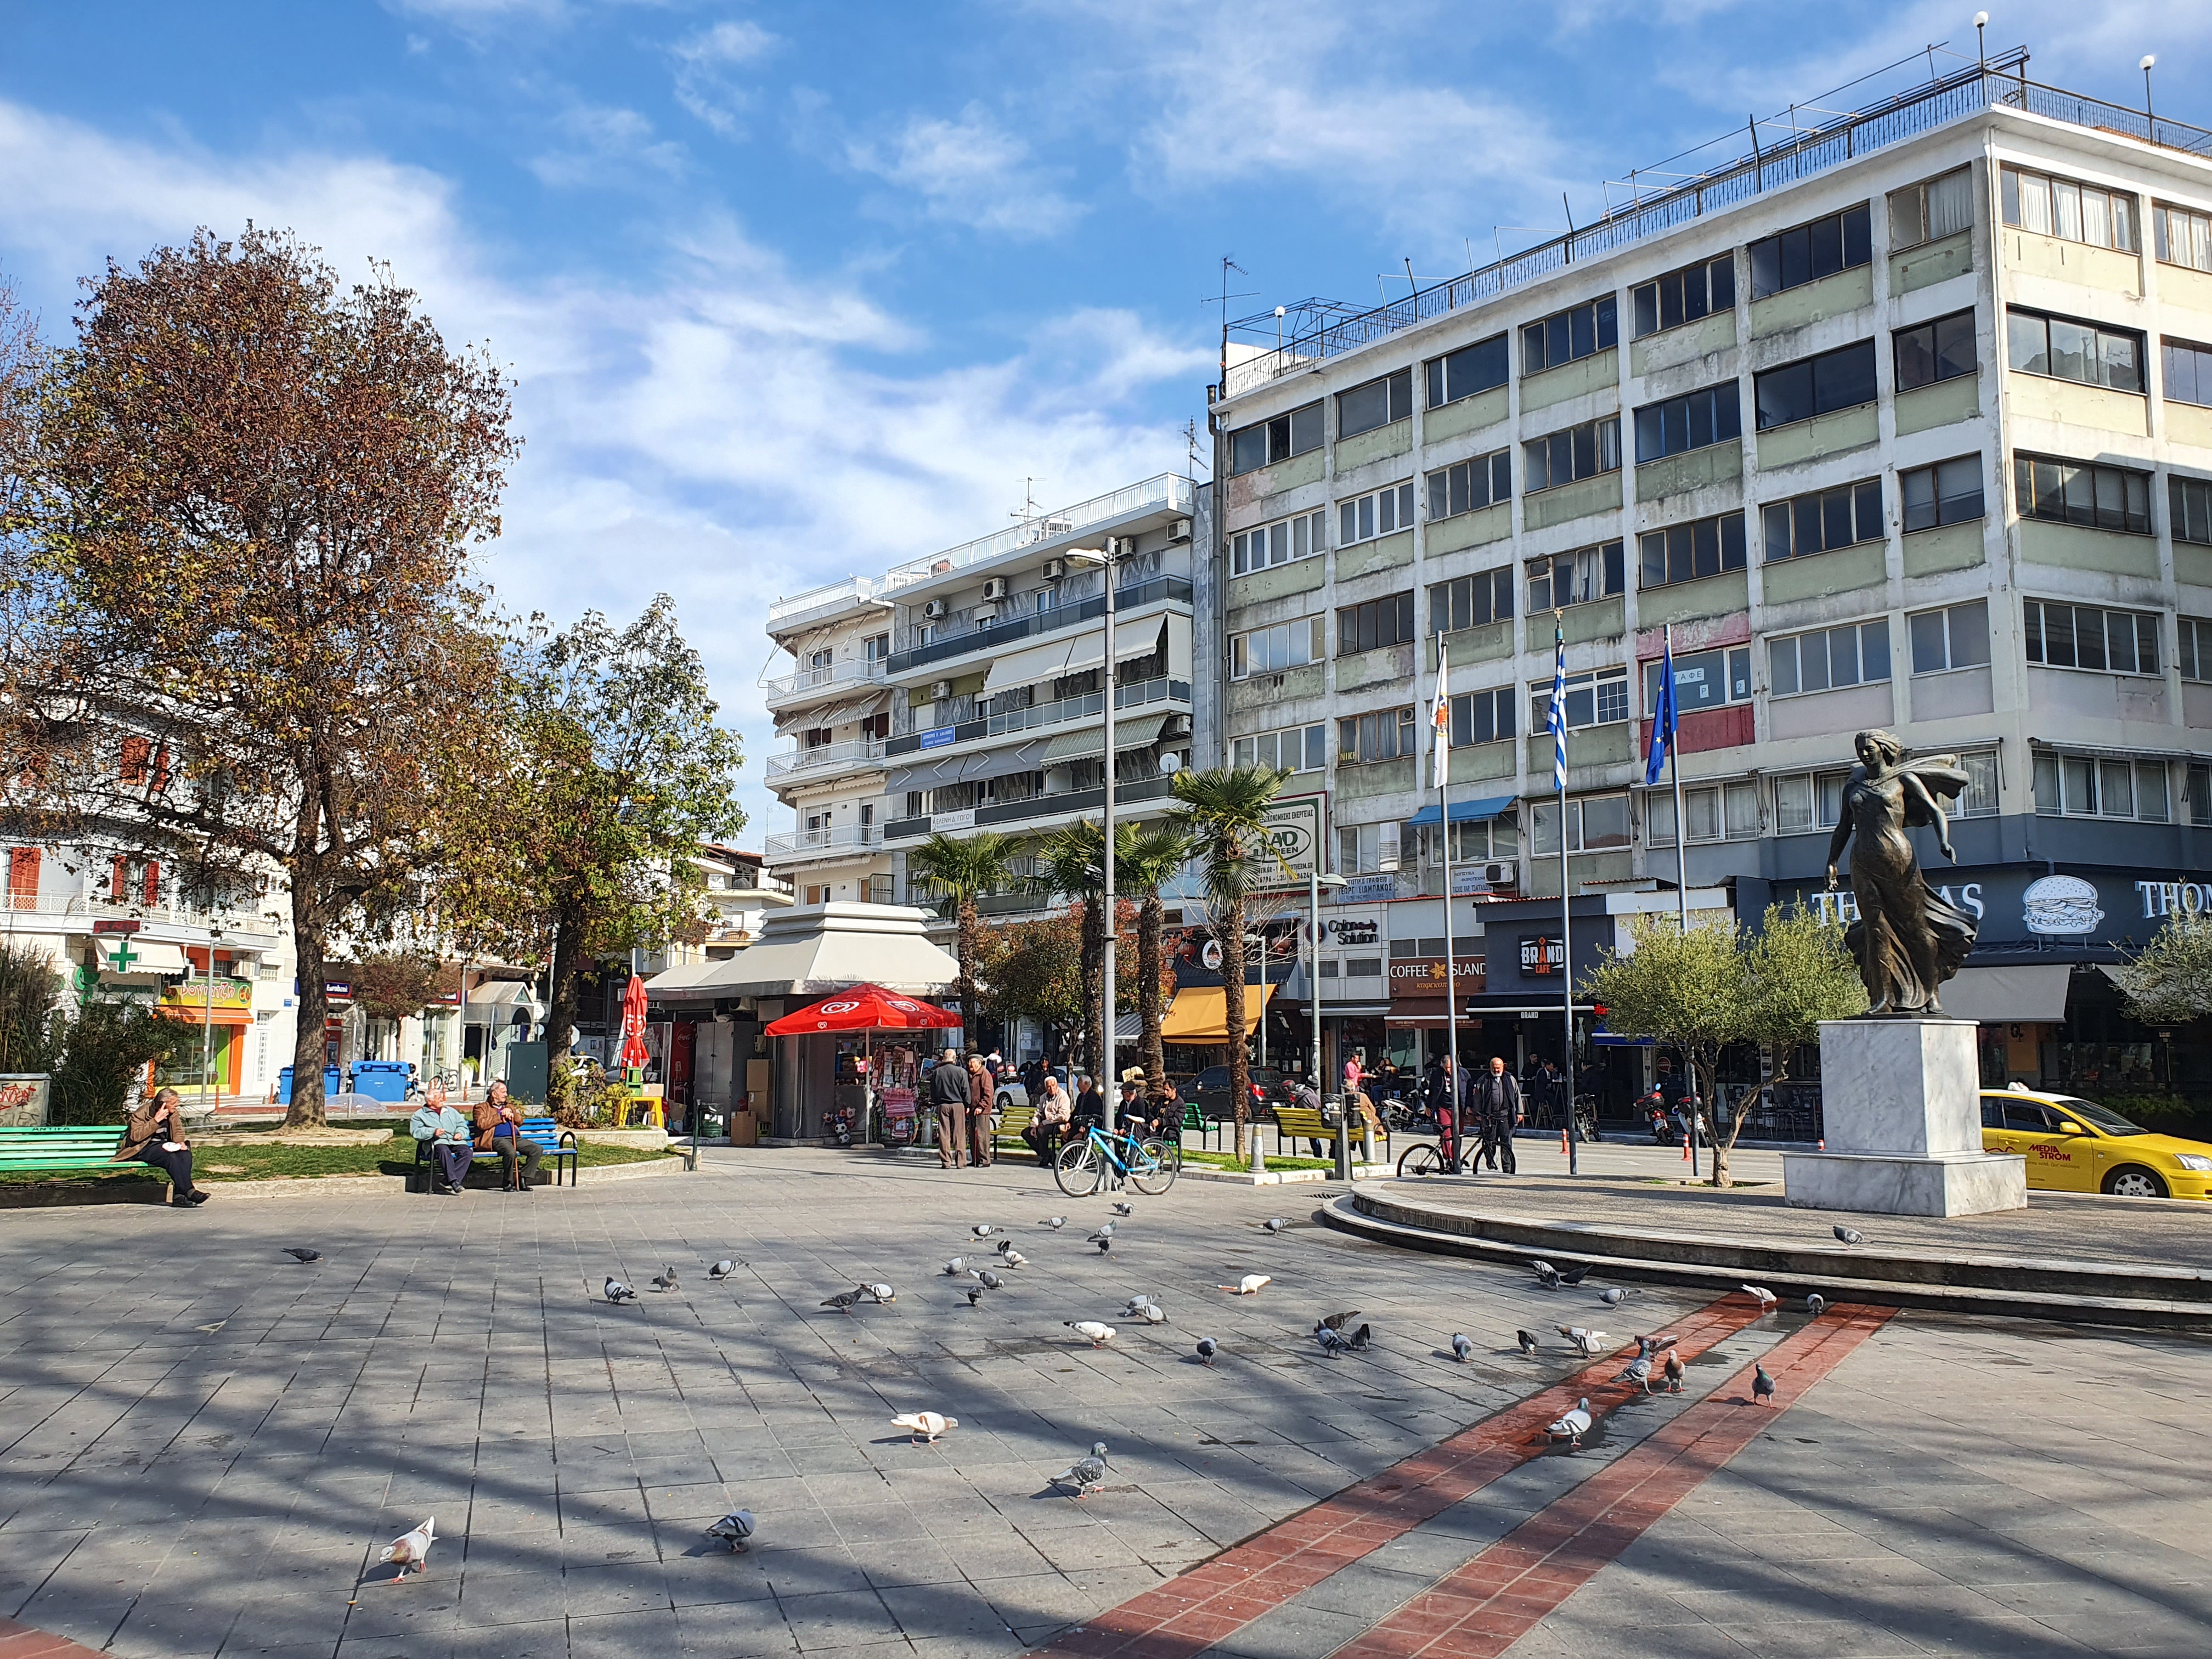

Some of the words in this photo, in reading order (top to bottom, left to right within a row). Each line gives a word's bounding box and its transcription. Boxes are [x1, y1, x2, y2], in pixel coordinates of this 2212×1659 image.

[1291, 809, 1313, 819] ΕΝΕΡΓΕΙΑΣ
[936, 816, 951, 825] ΕΛΕΝΗ
[1359, 883, 1392, 893] ΣΙΑΜΠΑΚΟΣ
[1328, 919, 1355, 933] Color
[1338, 932, 1379, 945] Solution
[1521, 945, 1564, 964] BRAND
[1390, 964, 1429, 978] COFFEE
[1452, 963, 1486, 976] SLAND
[1536, 964, 1550, 974] CAFE
[1417, 979, 1461, 990] καφεκοπίο
[2028, 1144, 2059, 1153] MEDIA
[2039, 1152, 2071, 1161] STROM
